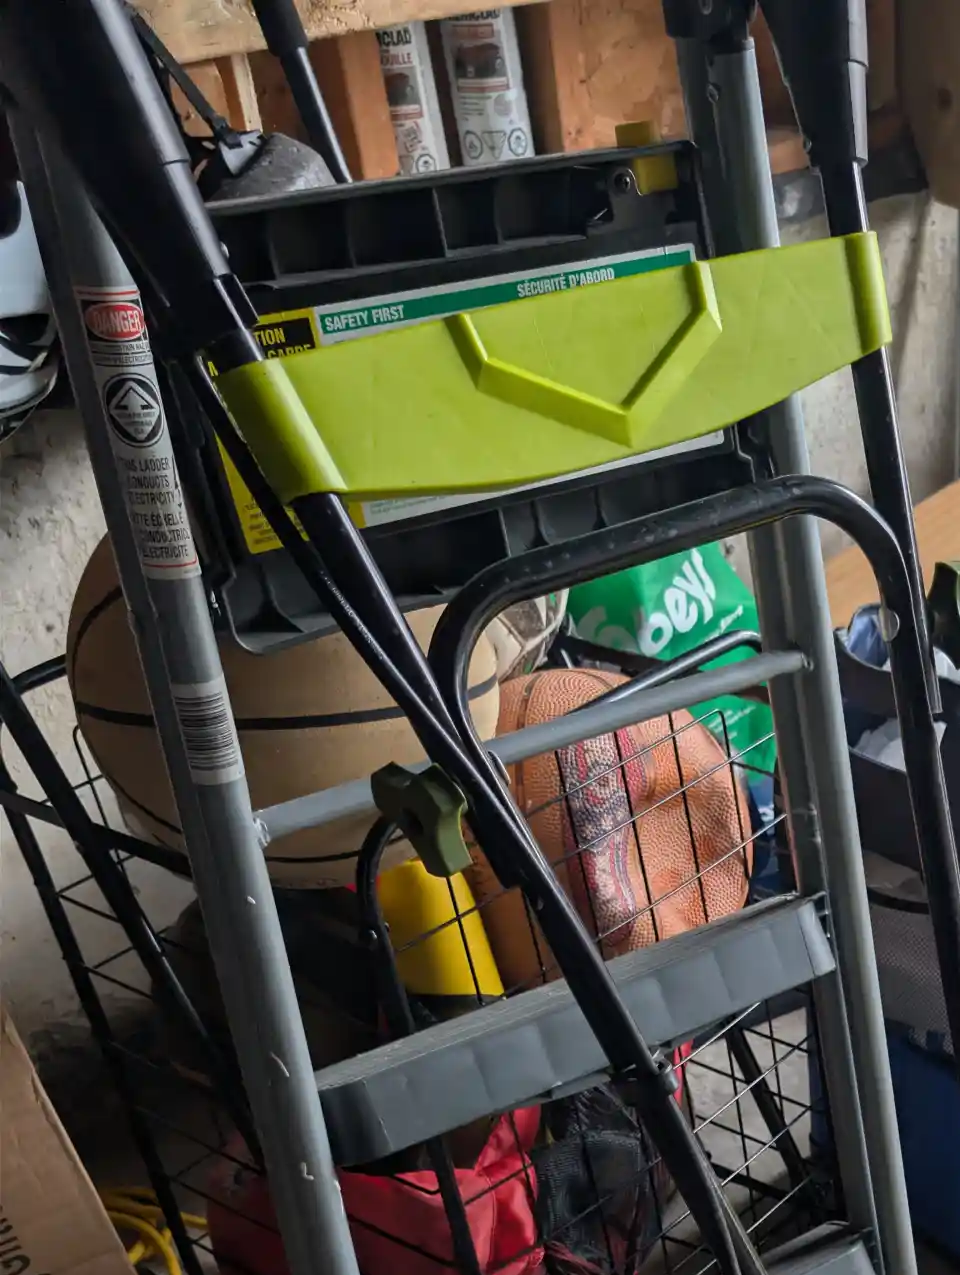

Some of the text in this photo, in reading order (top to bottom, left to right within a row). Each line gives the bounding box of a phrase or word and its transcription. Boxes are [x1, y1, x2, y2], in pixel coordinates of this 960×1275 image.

[516, 267, 616, 297] SÉCURITÉ D'ABORD
[93, 309, 142, 333] DANGER
[324, 304, 405, 331] SAFETY FIRST
[139, 456, 172, 473] LADDER
